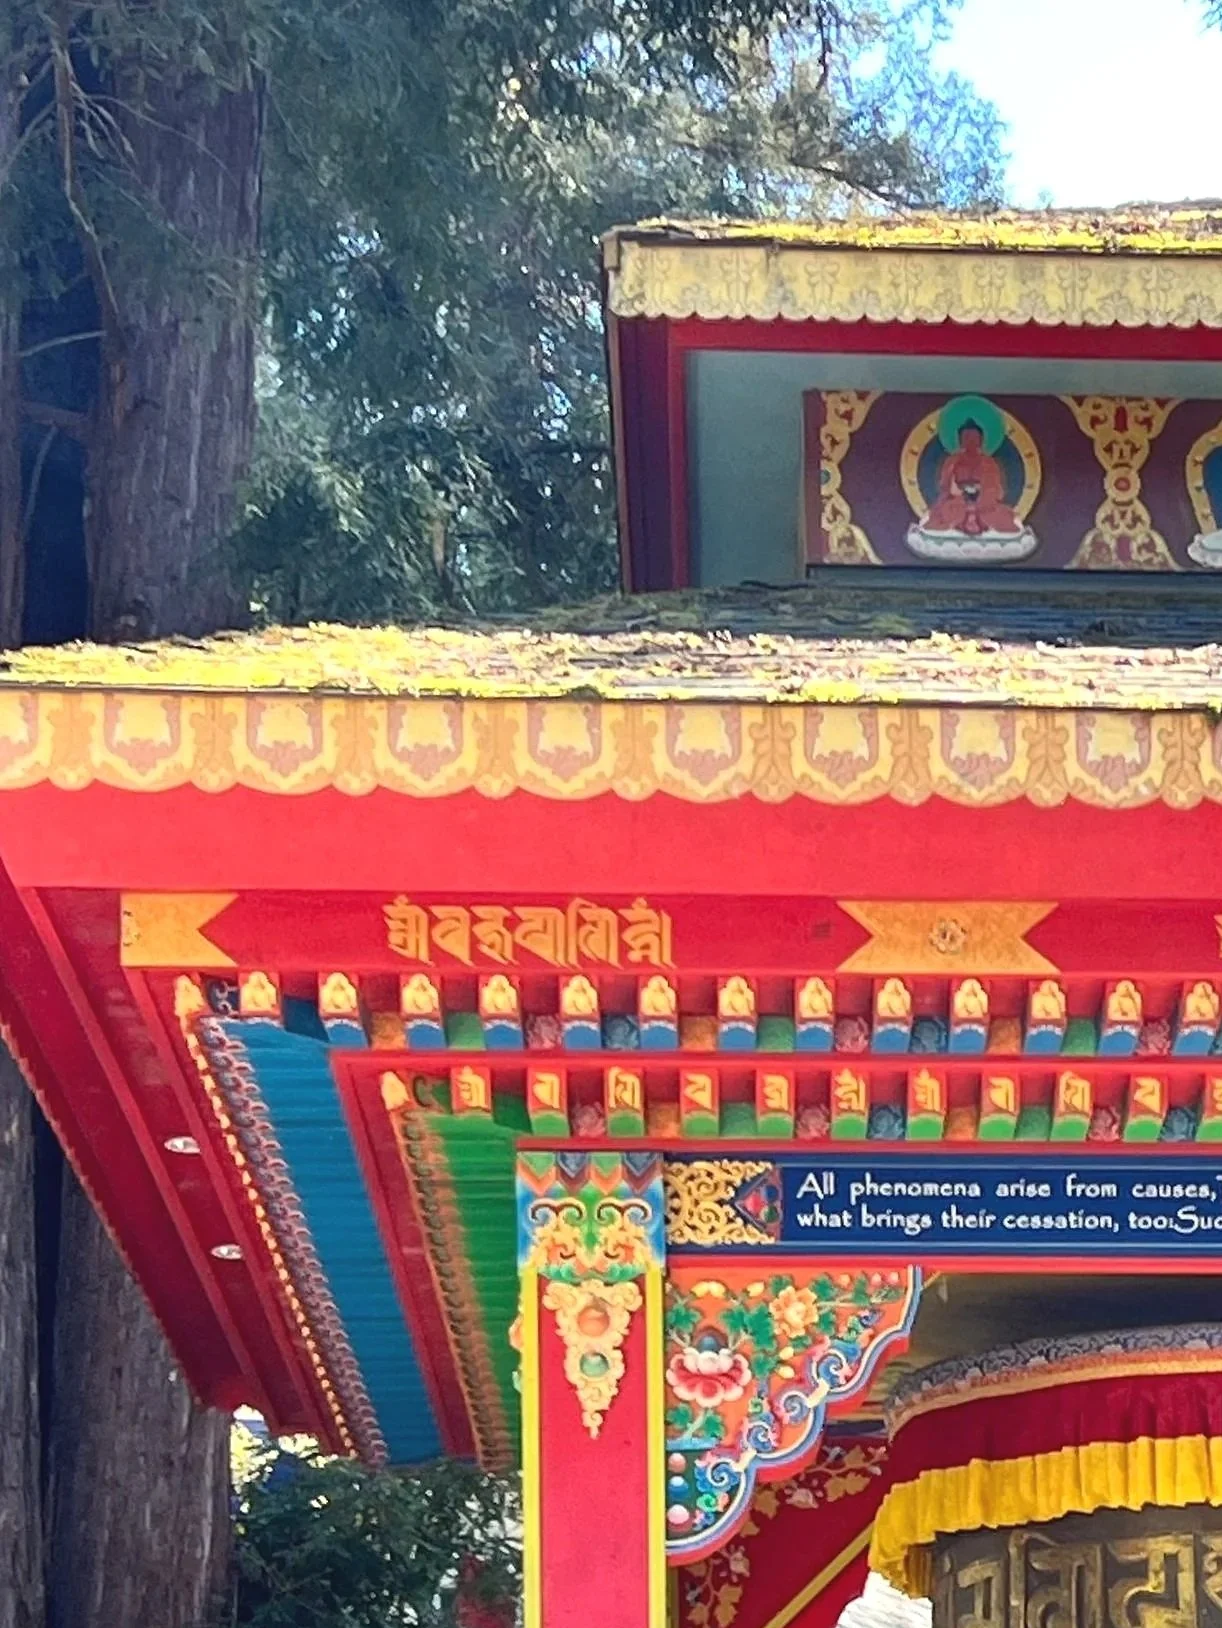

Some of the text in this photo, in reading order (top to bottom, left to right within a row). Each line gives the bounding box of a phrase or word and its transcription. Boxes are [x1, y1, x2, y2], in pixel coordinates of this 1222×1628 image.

[796, 1172, 835, 1196] All
[850, 1173, 981, 1206] phenomena
[995, 1178, 1051, 1198] arise
[1066, 1174, 1117, 1197] from
[796, 1204, 853, 1228] what
[861, 1204, 932, 1236] brings
[941, 1204, 997, 1229] their
[1002, 1209, 1119, 1233] cessation,
